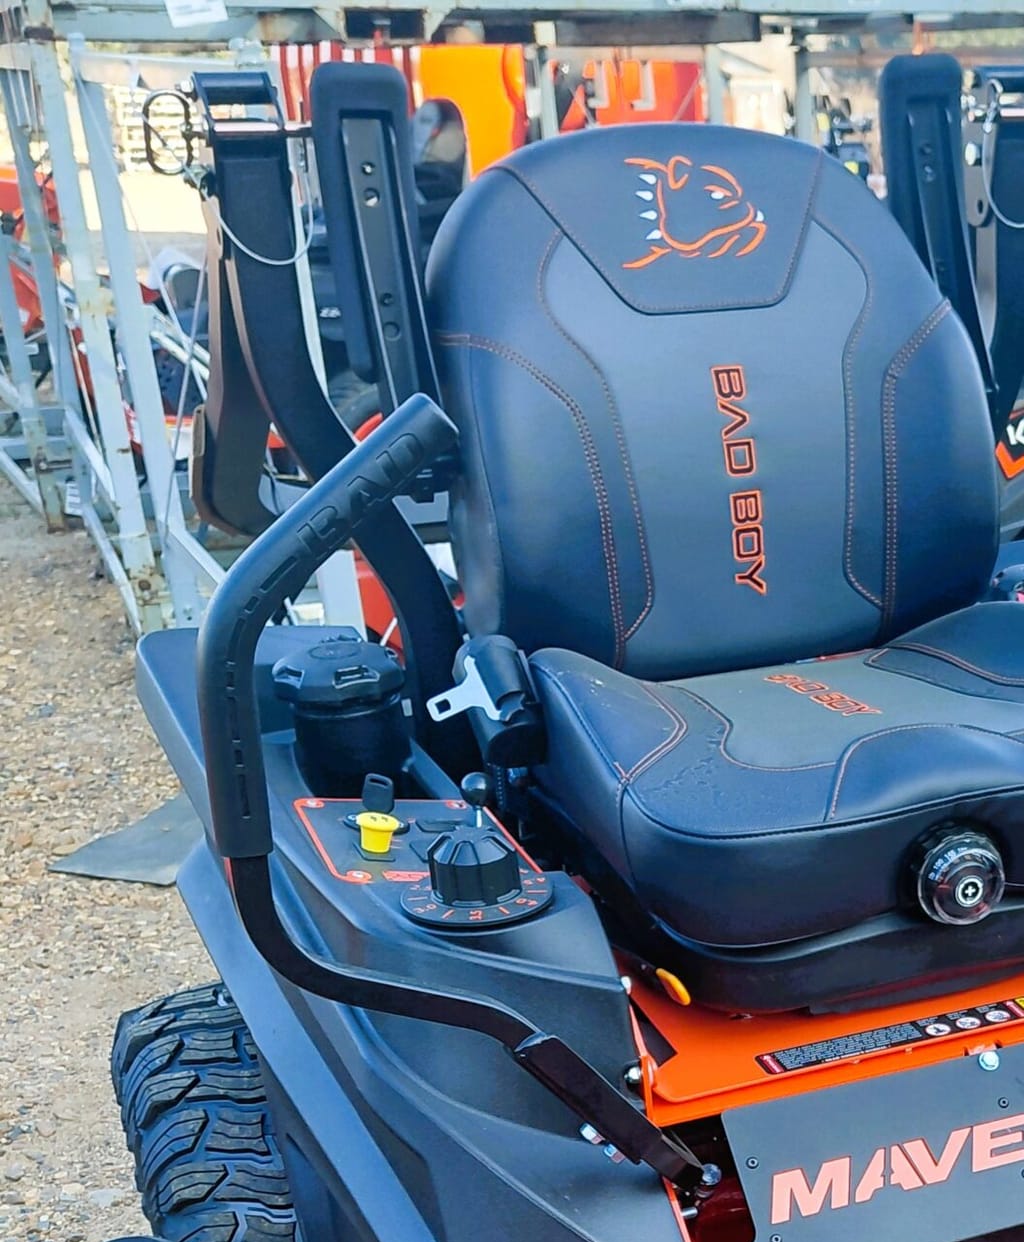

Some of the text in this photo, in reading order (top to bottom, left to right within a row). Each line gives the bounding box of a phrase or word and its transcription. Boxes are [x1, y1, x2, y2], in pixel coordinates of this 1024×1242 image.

[710, 364, 767, 596] BAD BOY
[808, 691, 883, 717] BOY
